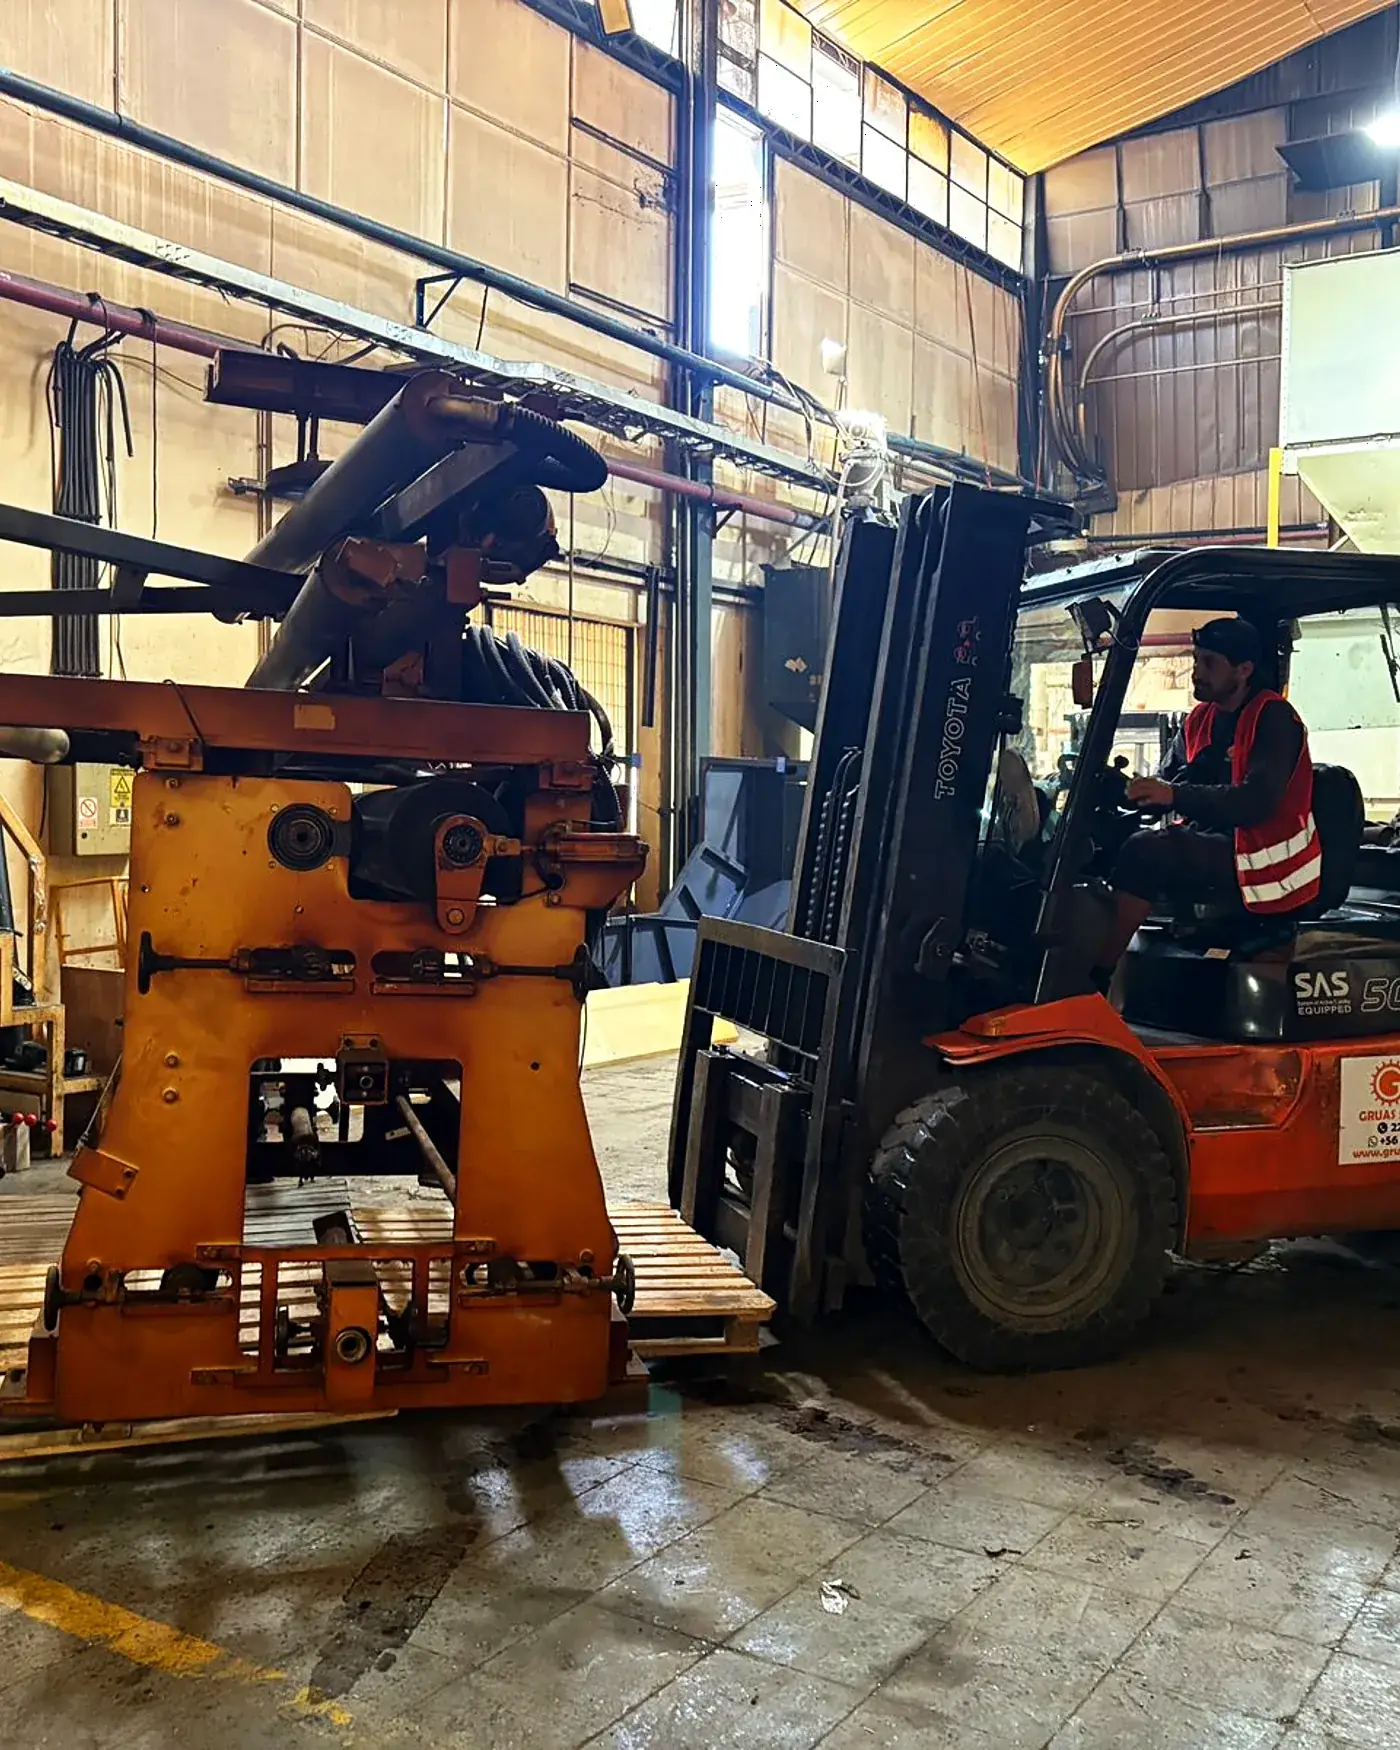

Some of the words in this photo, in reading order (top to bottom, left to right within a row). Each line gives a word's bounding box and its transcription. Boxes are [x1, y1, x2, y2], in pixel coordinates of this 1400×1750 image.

[934, 677, 971, 800] TOYOTA
[1294, 971, 1349, 998] SAS
[1297, 1005, 1352, 1016] EQUIPPED
[1359, 1110, 1396, 1121] GRUAS
[1380, 1136, 1398, 1145] +56
